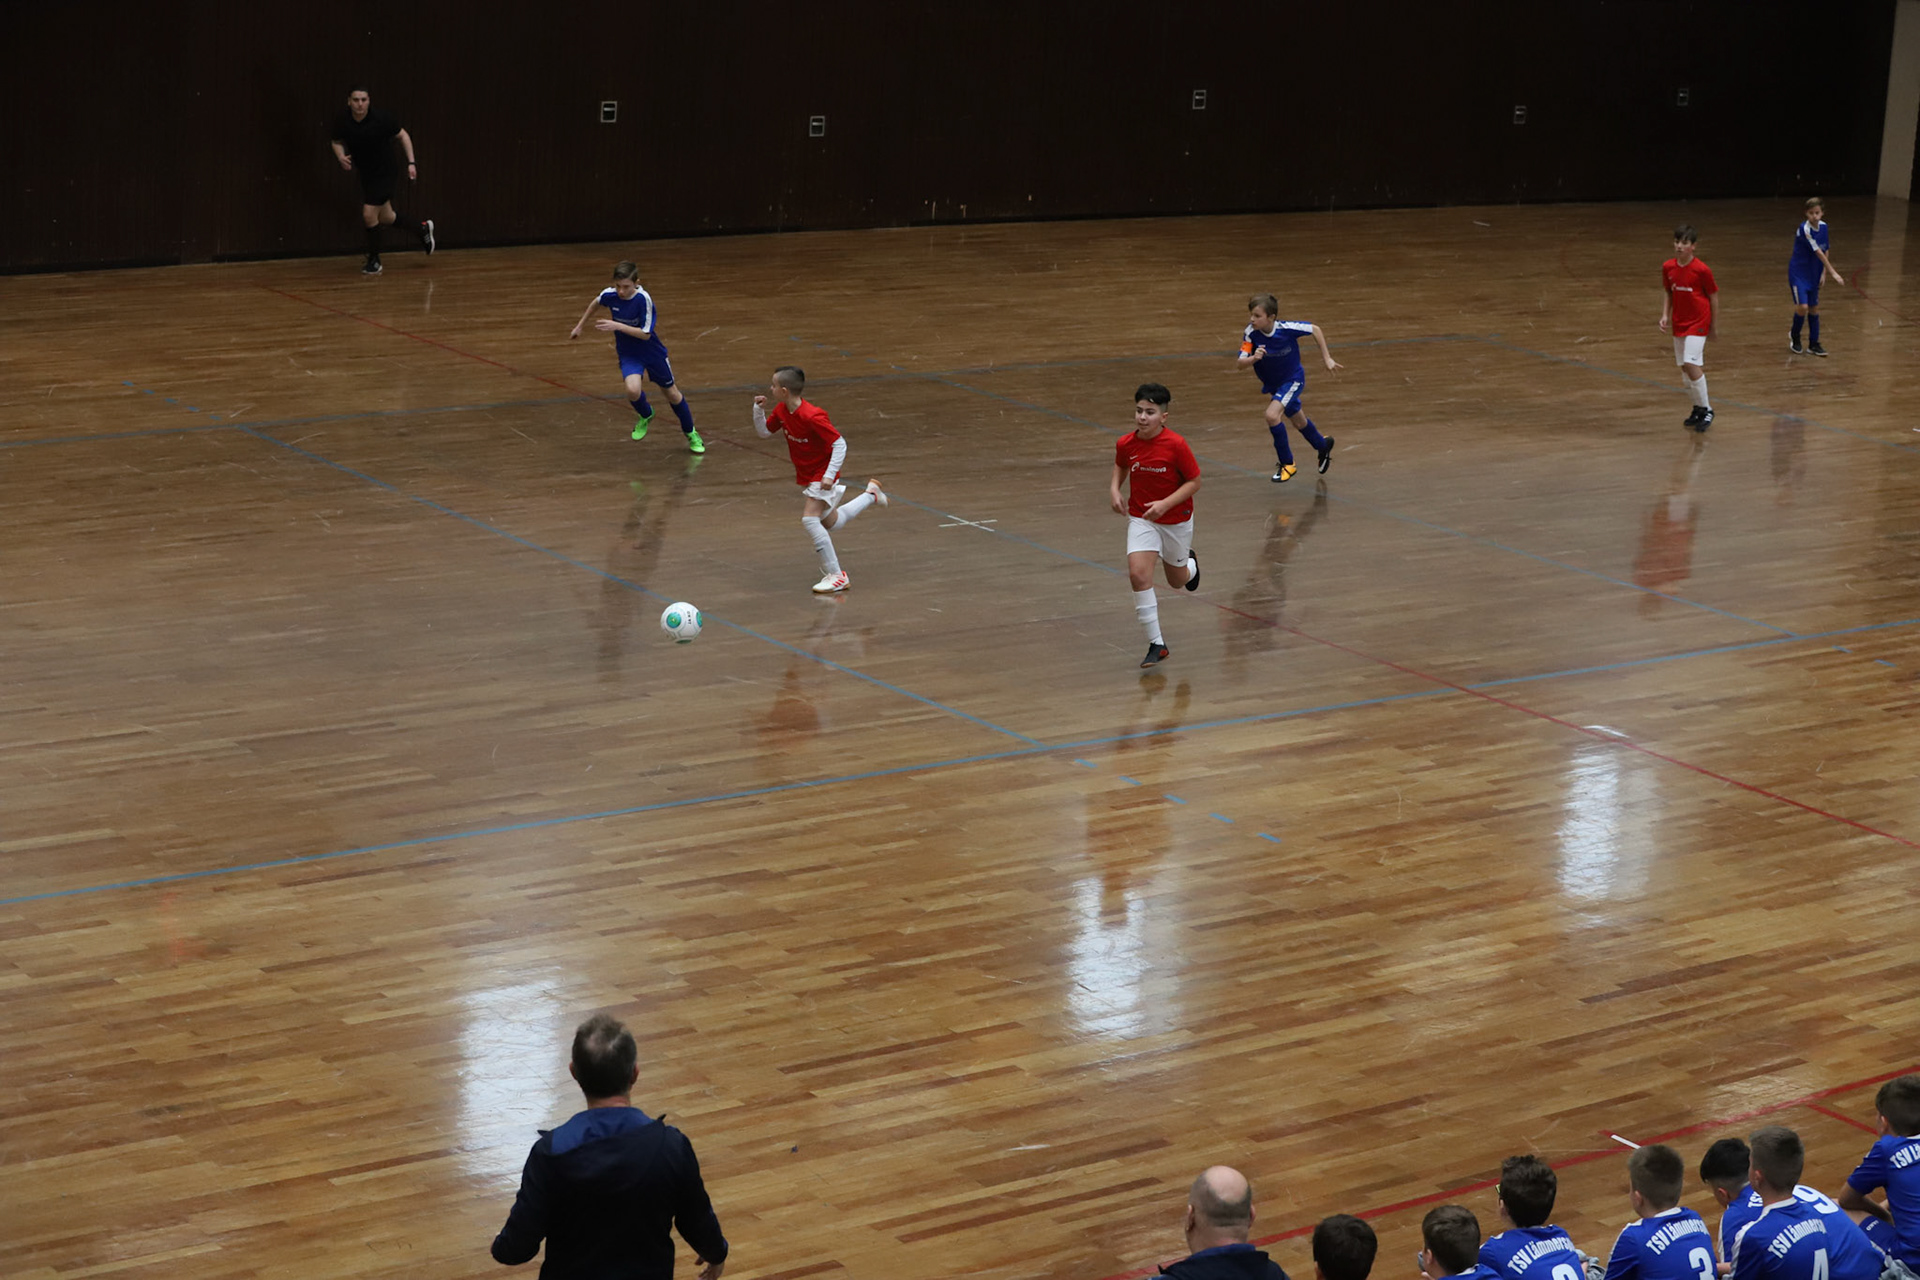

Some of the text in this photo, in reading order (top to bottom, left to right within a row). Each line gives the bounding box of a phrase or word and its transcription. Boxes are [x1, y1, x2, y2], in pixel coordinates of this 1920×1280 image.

[1889, 1147, 1914, 1169] TSV
[1792, 1184, 1840, 1214] 9
[1645, 1226, 1671, 1255] TSV
[1767, 1232, 1792, 1259] TSV
[1507, 1248, 1533, 1275] TSV
